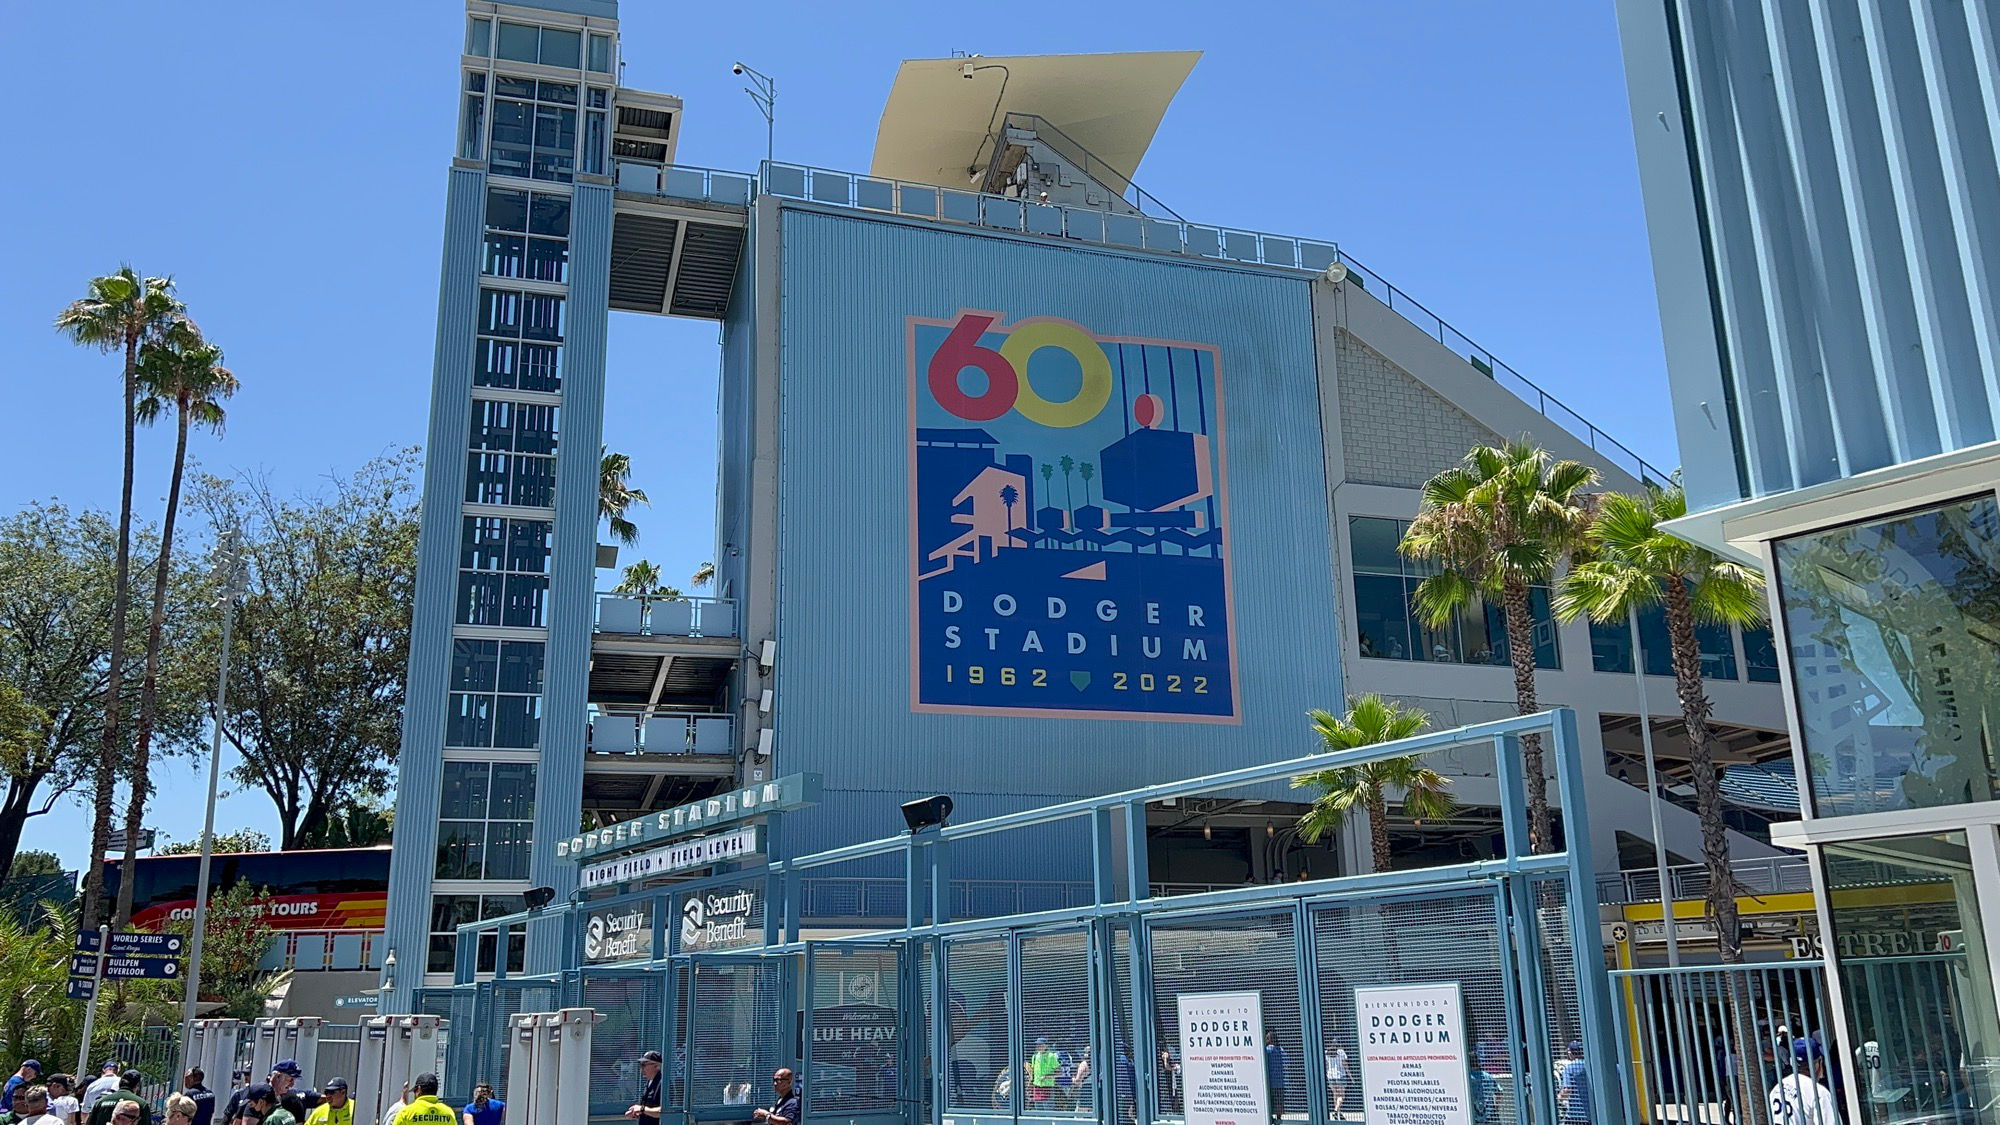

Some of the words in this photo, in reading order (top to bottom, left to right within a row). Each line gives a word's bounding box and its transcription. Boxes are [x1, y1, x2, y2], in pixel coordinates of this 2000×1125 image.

[928, 314, 1112, 428] 60
[943, 590, 1205, 628] DODGER
[945, 625, 1208, 661] STADIUM
[946, 664, 1048, 687] 1962
[1112, 672, 1209, 694] 2022
[558, 821, 642, 857] DODGER
[658, 783, 779, 830] STADIUM
[589, 865, 618, 882] RIGHT
[623, 859, 651, 876] FIELD
[671, 842, 702, 864] FIELD
[709, 836, 743, 856] LEVEL
[271, 901, 318, 916] TOURS
[706, 889, 753, 917] Security
[605, 909, 644, 934] Security
[705, 916, 747, 944] Benefit
[113, 934, 138, 943] WORLD
[140, 935, 163, 944] SERIES
[604, 933, 638, 958] Benefit
[1788, 929, 1940, 960] ESTREL
[109, 958, 139, 967] BULLPEN
[107, 967, 145, 976] OVERLOOK
[1365, 1000, 1436, 1009] BIENVENIDOS
[412, 1016, 419, 1026] 3
[434, 1016, 440, 1027] 3
[1190, 1020, 1249, 1033] DODGER
[1371, 1013, 1446, 1028] DODGER
[812, 1026, 844, 1041] LUE
[850, 1025, 897, 1041] HEAV
[1369, 1030, 1451, 1045] STADIUM
[1189, 1035, 1253, 1048] STADIUM
[1866, 1055, 1881, 1070] 50
[412, 1113, 451, 1124] SECURITY
